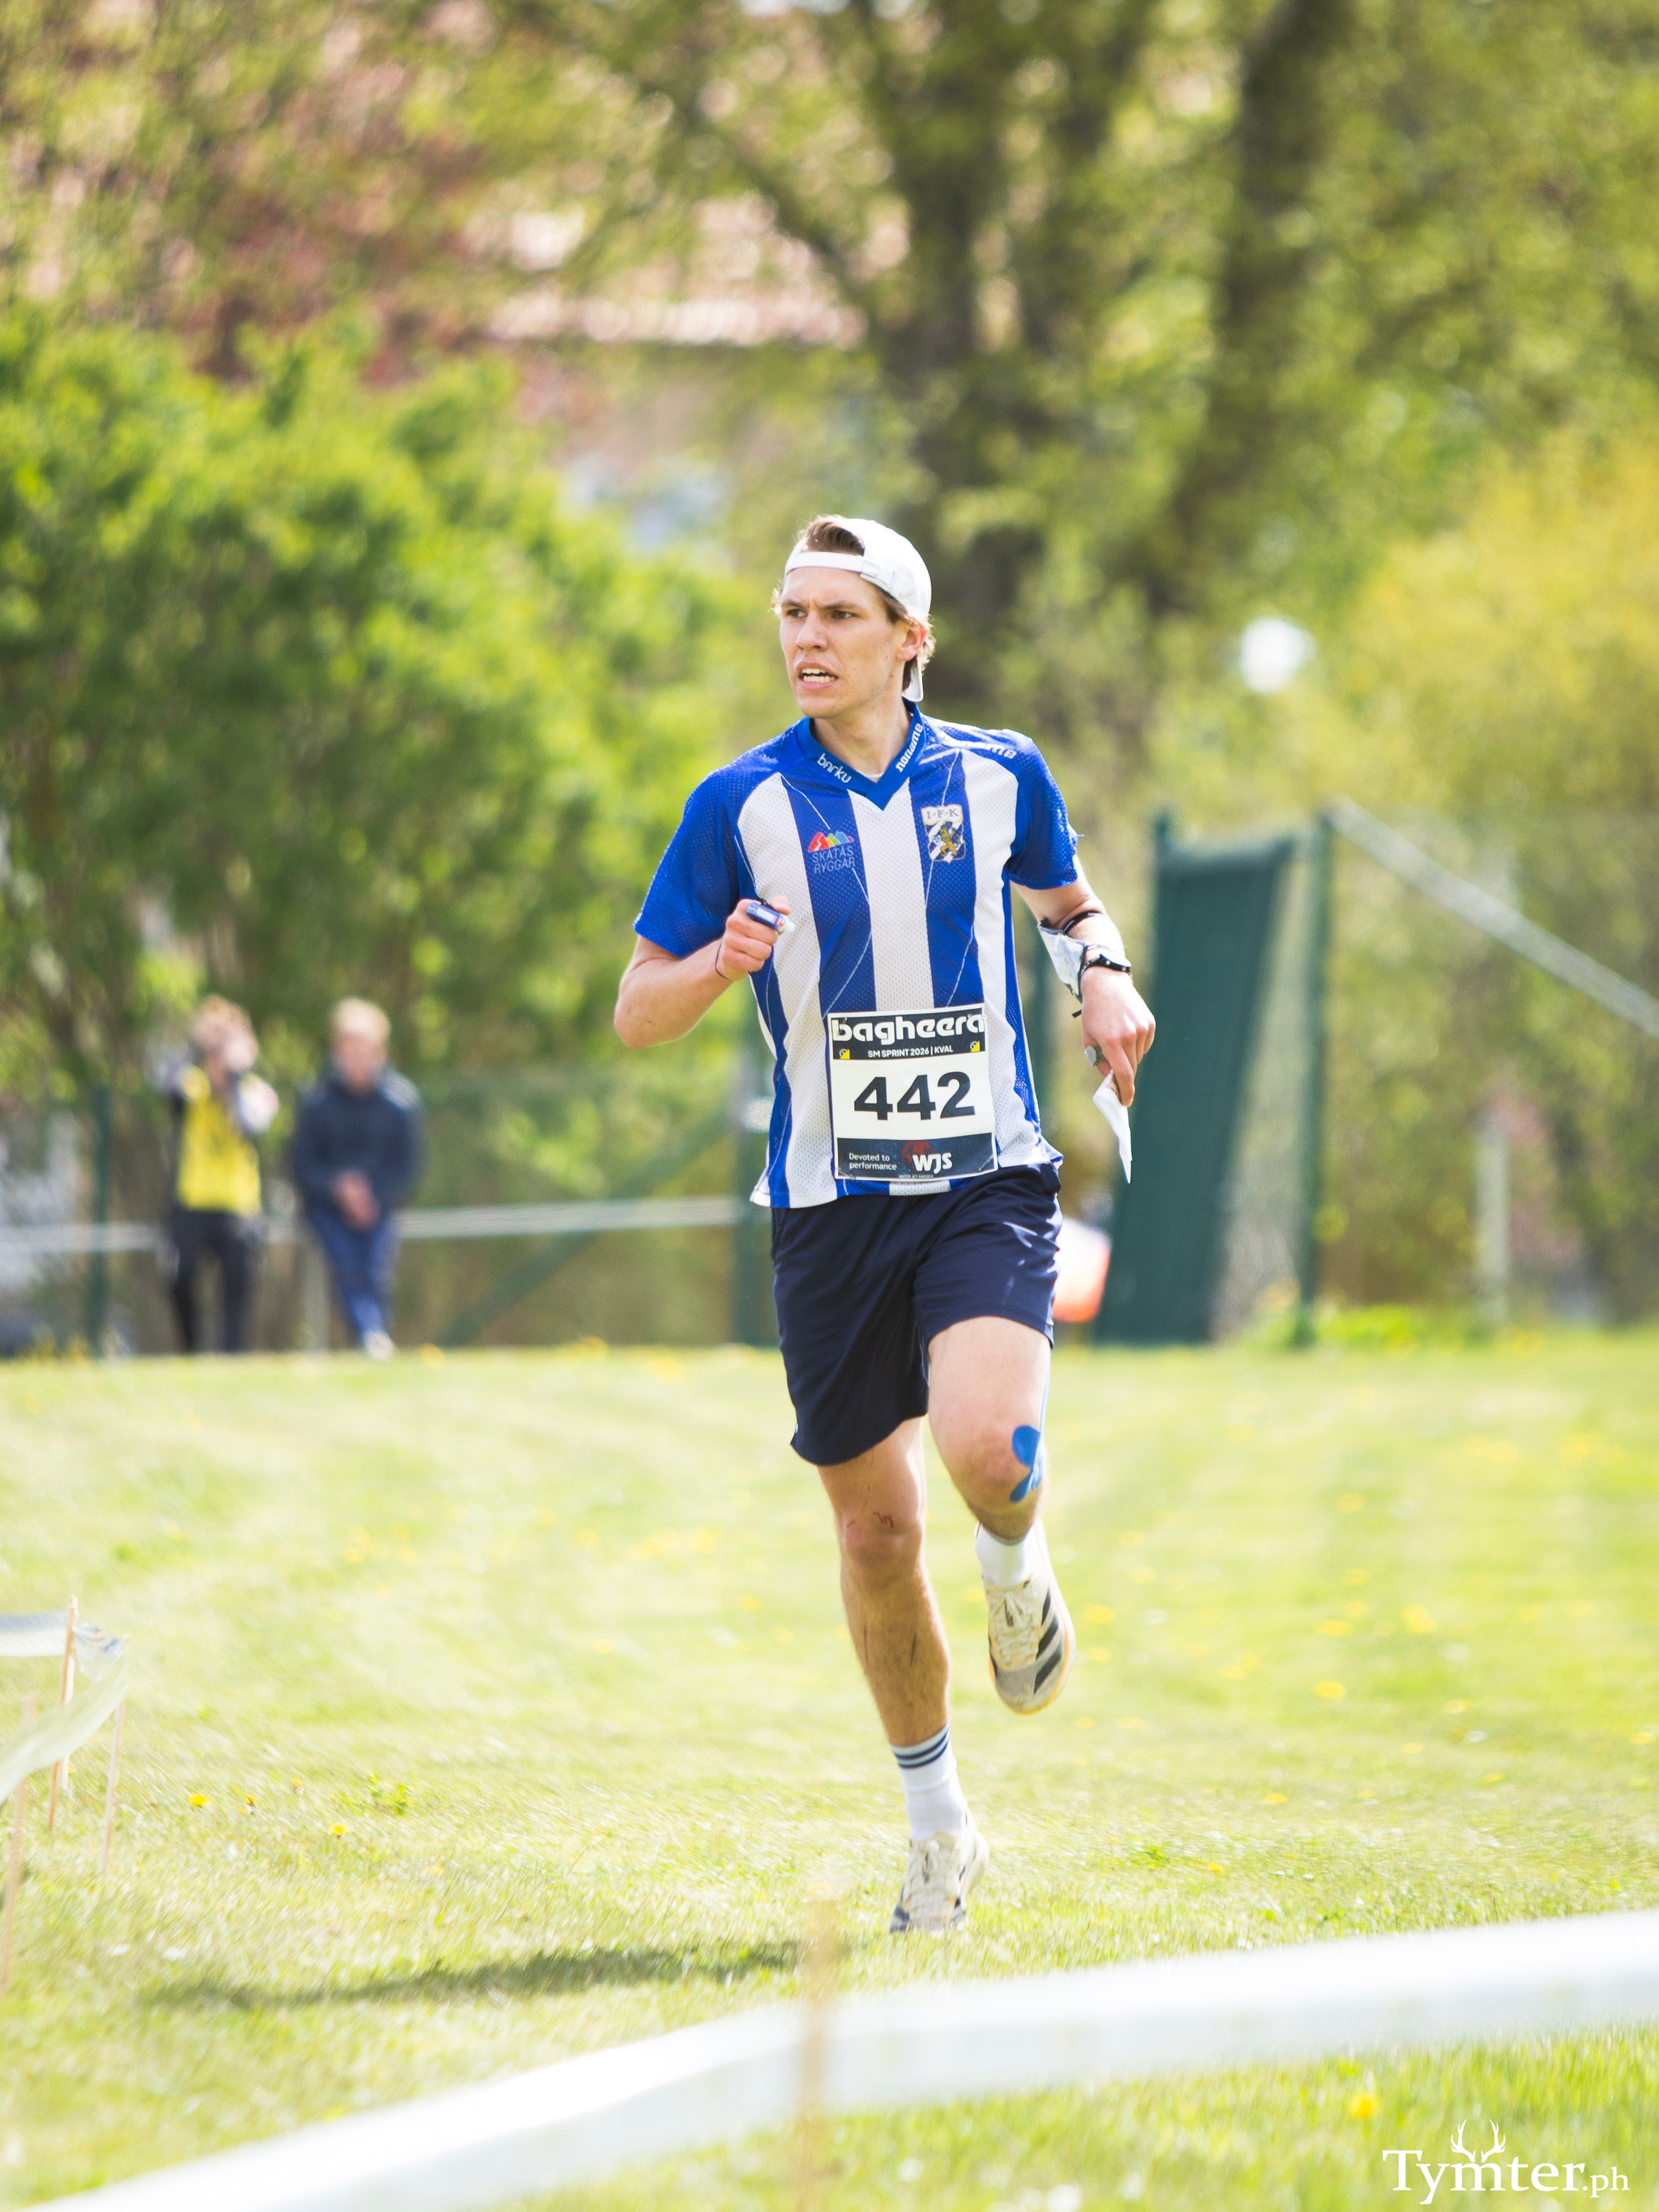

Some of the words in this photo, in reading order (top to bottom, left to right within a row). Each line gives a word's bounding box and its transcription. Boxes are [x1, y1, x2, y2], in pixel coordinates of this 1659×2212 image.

[895, 723, 923, 773] noname
[817, 753, 852, 784] barku
[814, 857, 855, 874] RYGGAR
[831, 1014, 985, 1045] bagheera
[868, 1049, 881, 1058] SM
[881, 1049, 910, 1058] SPRINT
[910, 1047, 930, 1056] 2026
[934, 1045, 954, 1054] KVAL
[853, 1071, 976, 1121] 442
[848, 1152, 880, 1161] Devoted
[849, 1161, 898, 1170] performance
[912, 1152, 953, 1175] WJS
